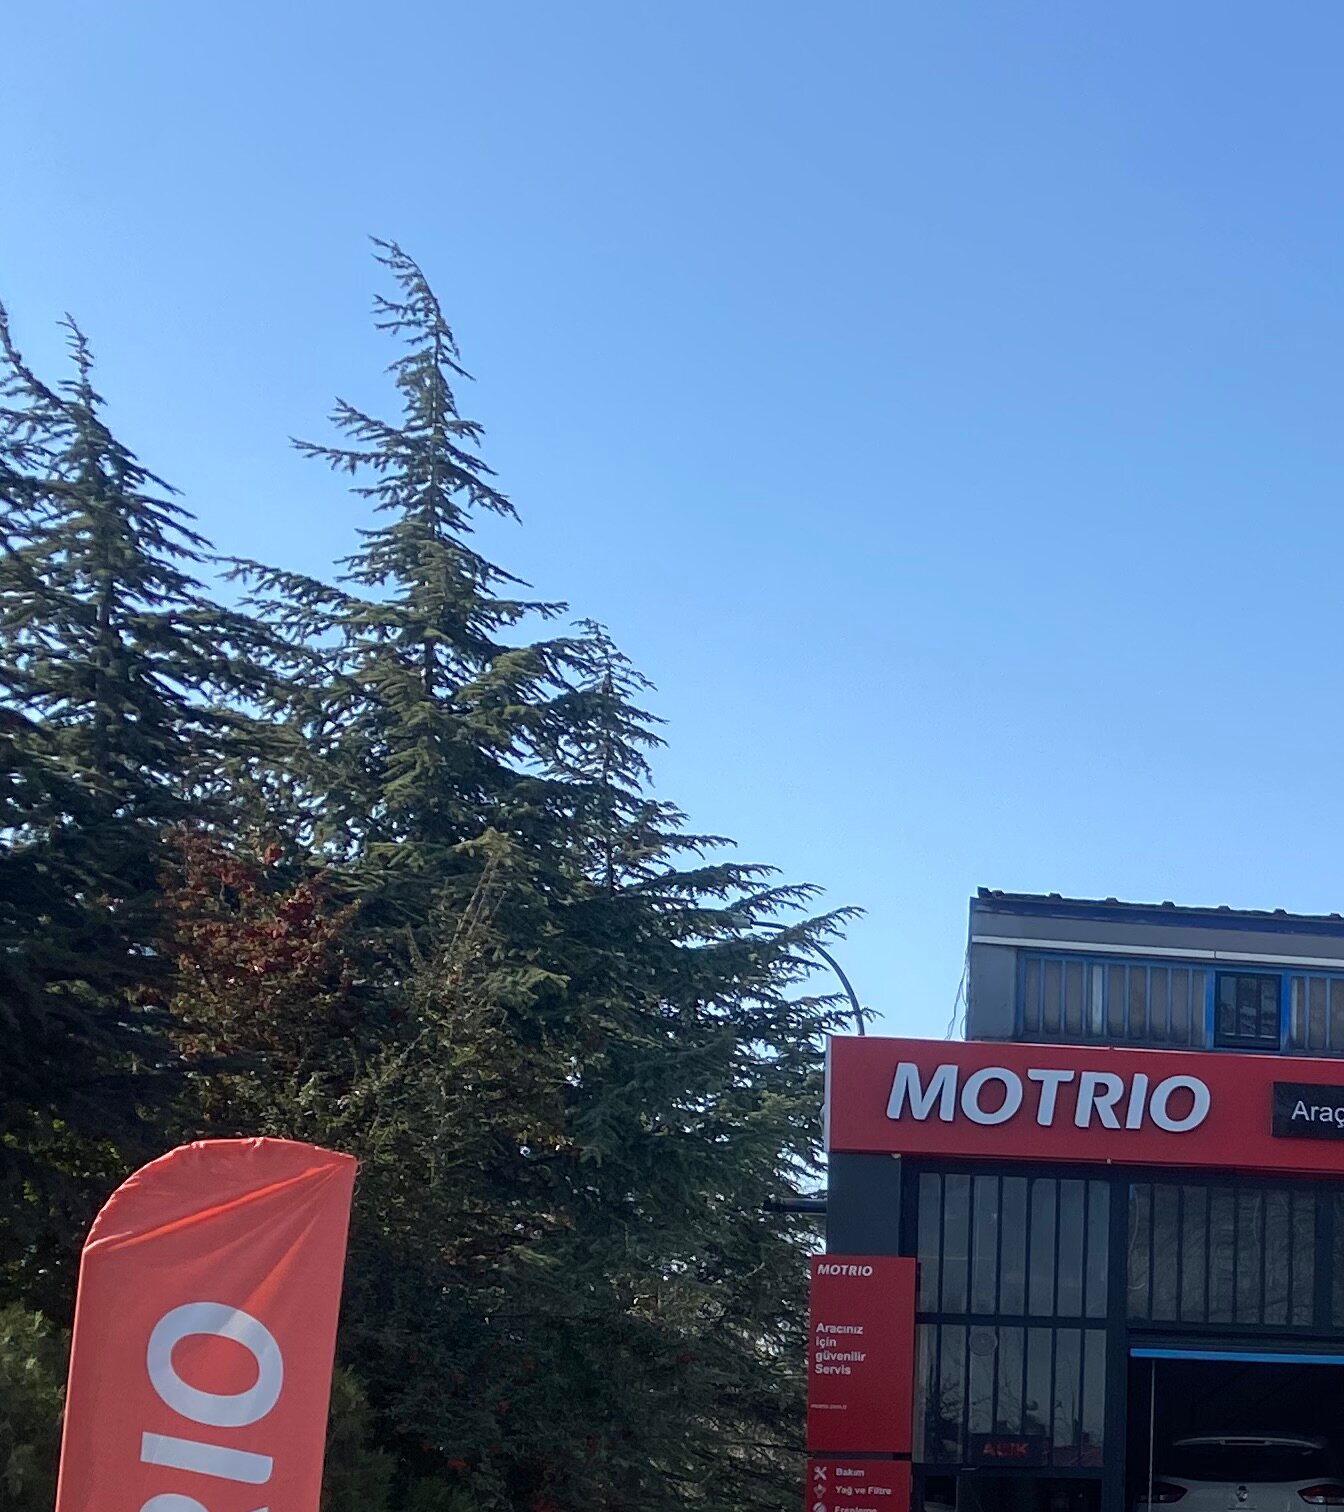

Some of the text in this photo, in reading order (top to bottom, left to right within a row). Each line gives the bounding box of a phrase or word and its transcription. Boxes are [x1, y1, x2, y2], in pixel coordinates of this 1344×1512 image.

[885, 1062, 1211, 1133] MOTRIO
[817, 1263, 873, 1277] MOTRIO
[816, 1322, 864, 1335] Aracınız
[816, 1336, 837, 1349] için
[815, 1350, 866, 1363] güvenilir
[815, 1364, 851, 1375] Servis
[835, 1486, 853, 1495] Yağ
[868, 1486, 892, 1495] Filtre
